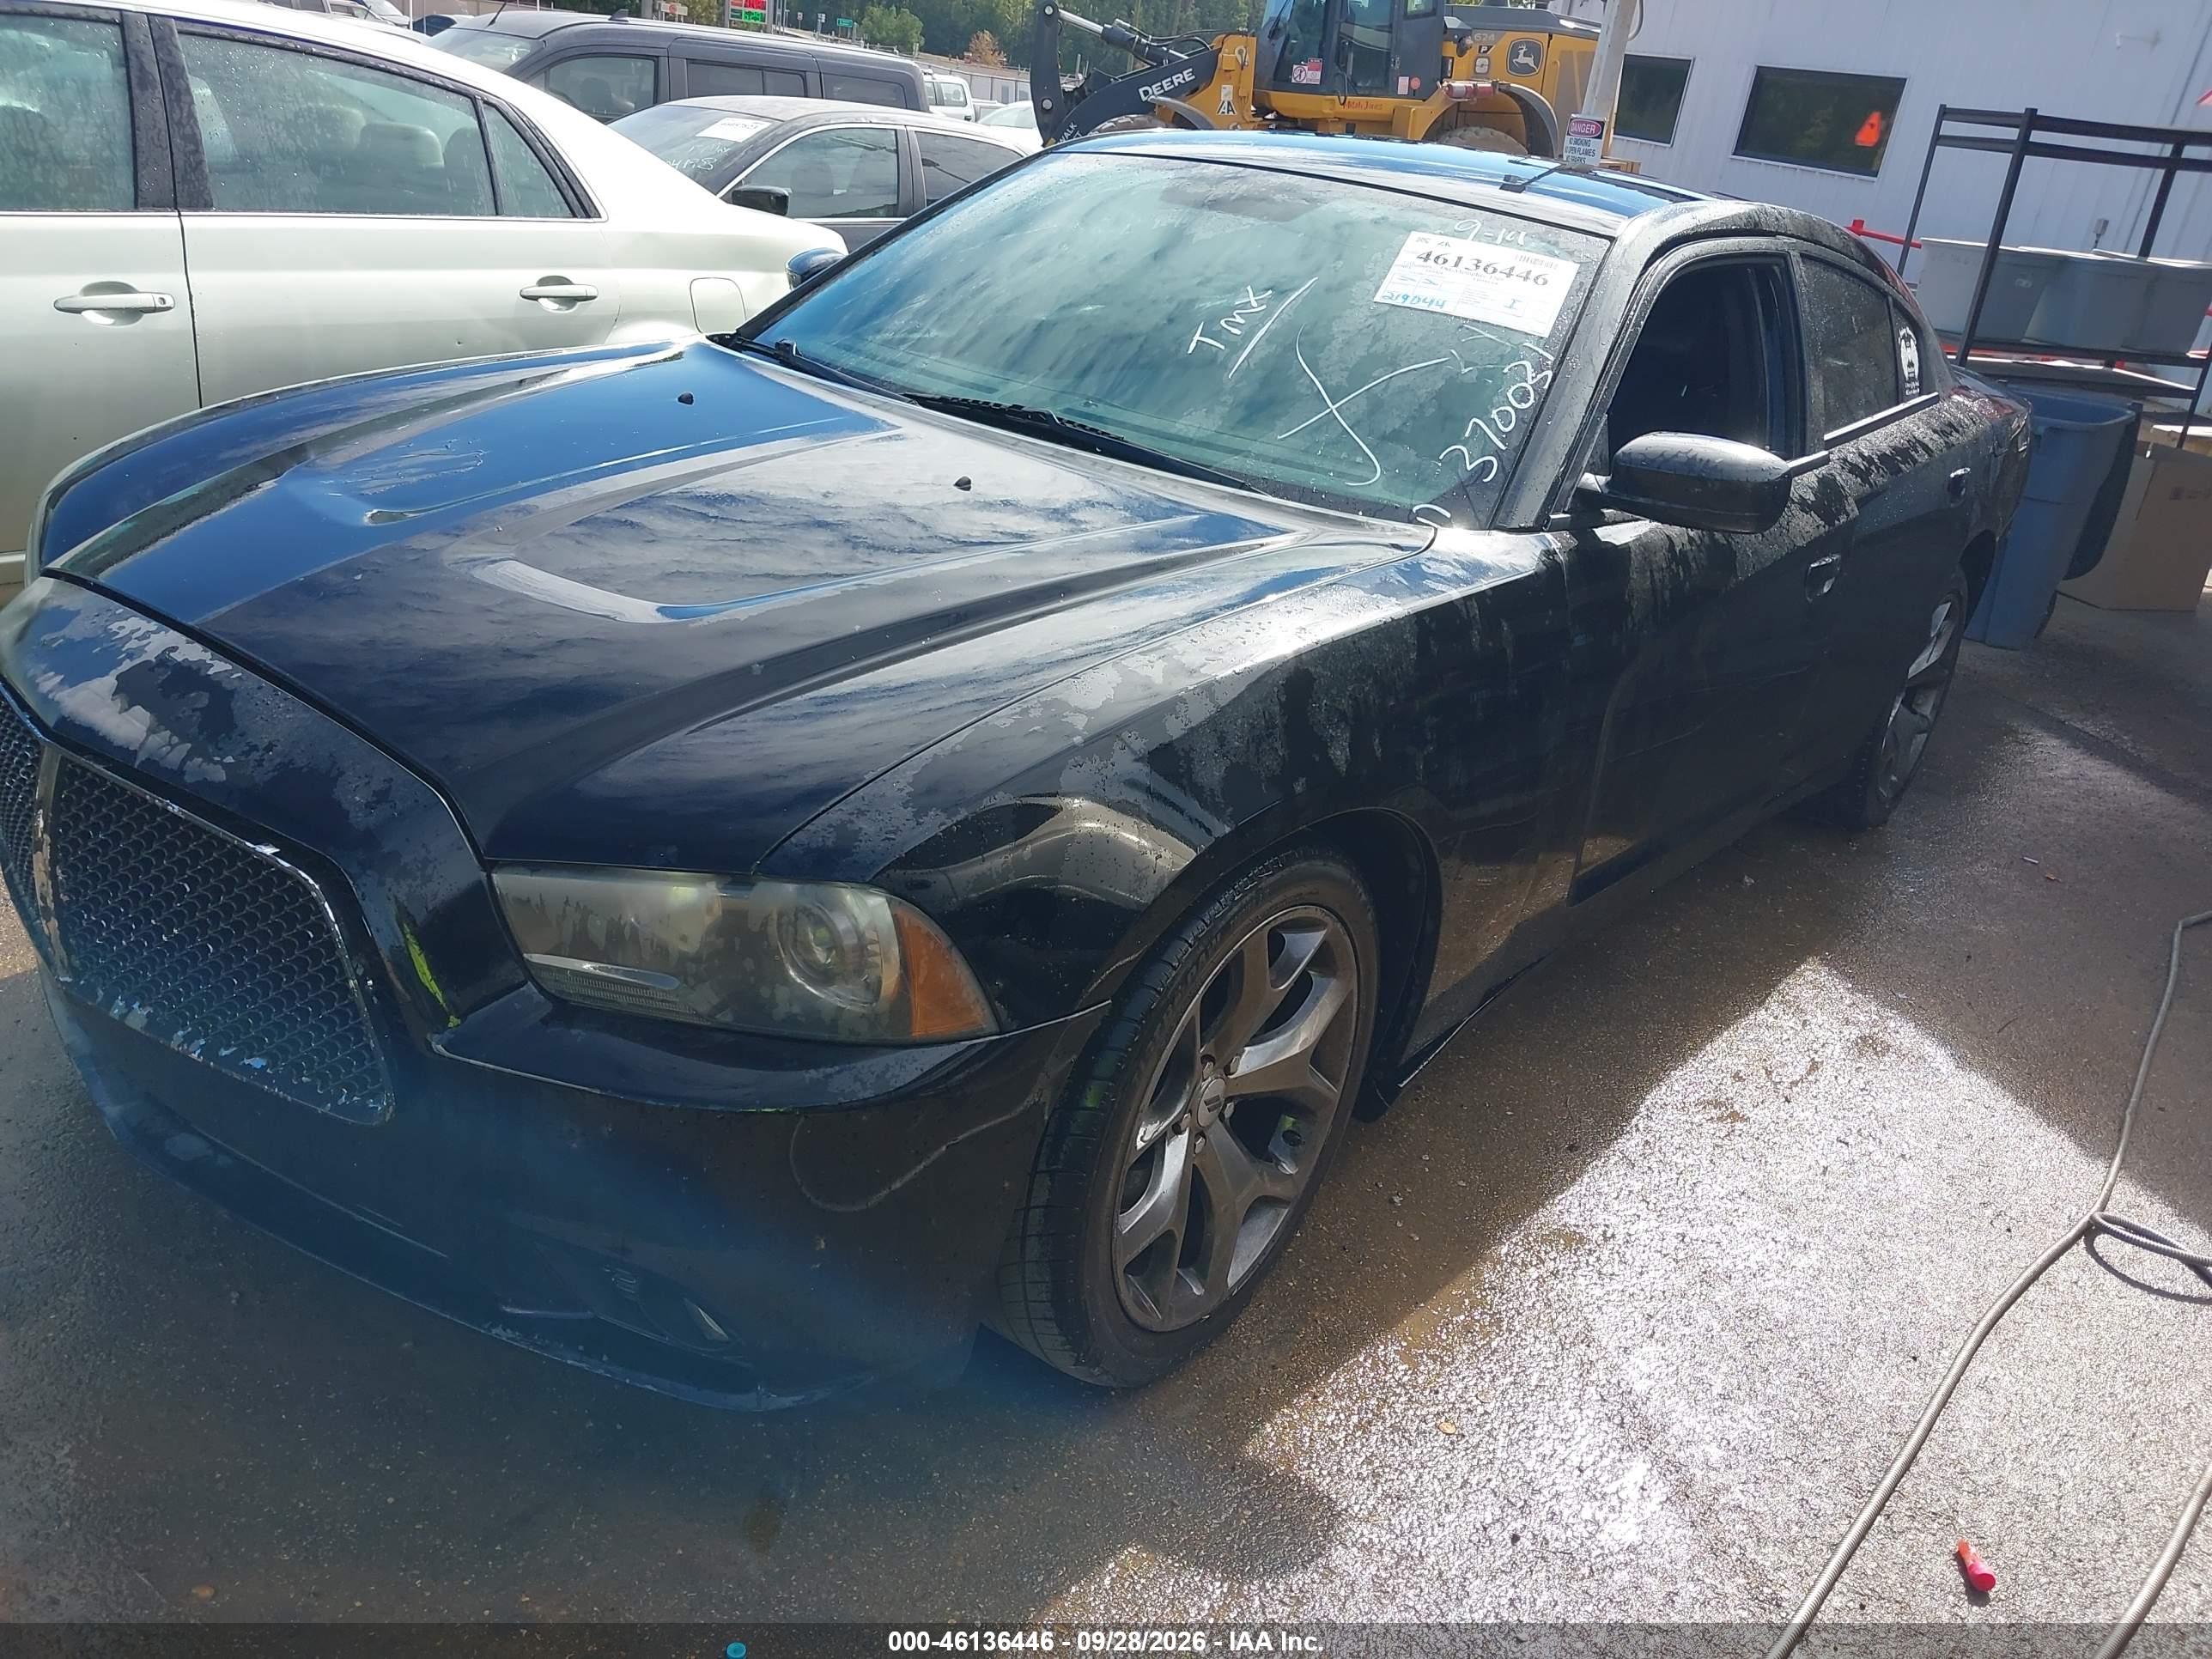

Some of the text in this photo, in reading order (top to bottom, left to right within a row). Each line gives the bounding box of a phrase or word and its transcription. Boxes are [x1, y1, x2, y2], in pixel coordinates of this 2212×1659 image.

[1138, 68, 1196, 102] DEERE
[1571, 122, 1596, 135] DANGER
[1577, 147, 1596, 157] FLAMES
[1416, 251, 1549, 286] 46136446
